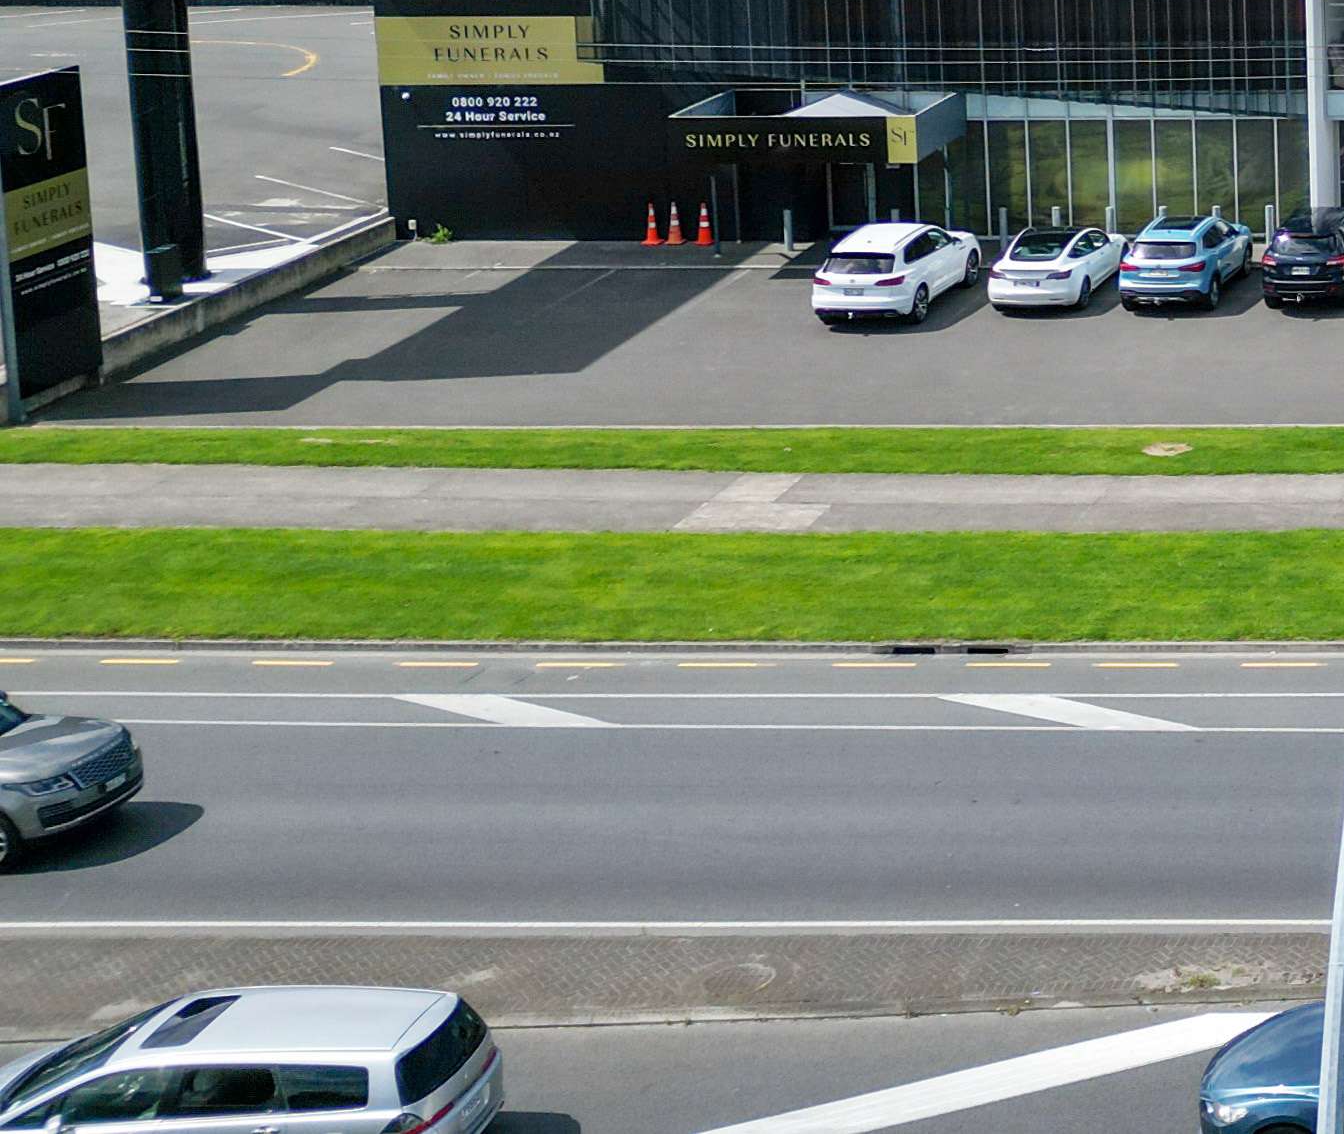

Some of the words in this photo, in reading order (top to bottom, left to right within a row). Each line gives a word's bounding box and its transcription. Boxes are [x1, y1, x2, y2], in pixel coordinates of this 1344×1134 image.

[449, 24, 531, 39] SIMPLY
[433, 47, 549, 62] FUNERALS
[452, 96, 483, 107] 0800
[487, 96, 510, 107] 920
[514, 96, 537, 107] 222
[445, 111, 462, 122] 24
[465, 111, 495, 122] Hour
[499, 110, 546, 122] Service
[14, 98, 66, 161] SF
[685, 133, 760, 148] SIMPLY
[768, 133, 871, 147] FUNERALS
[23, 182, 70, 210] SIMPLY
[14, 200, 83, 236] FUNERALS
